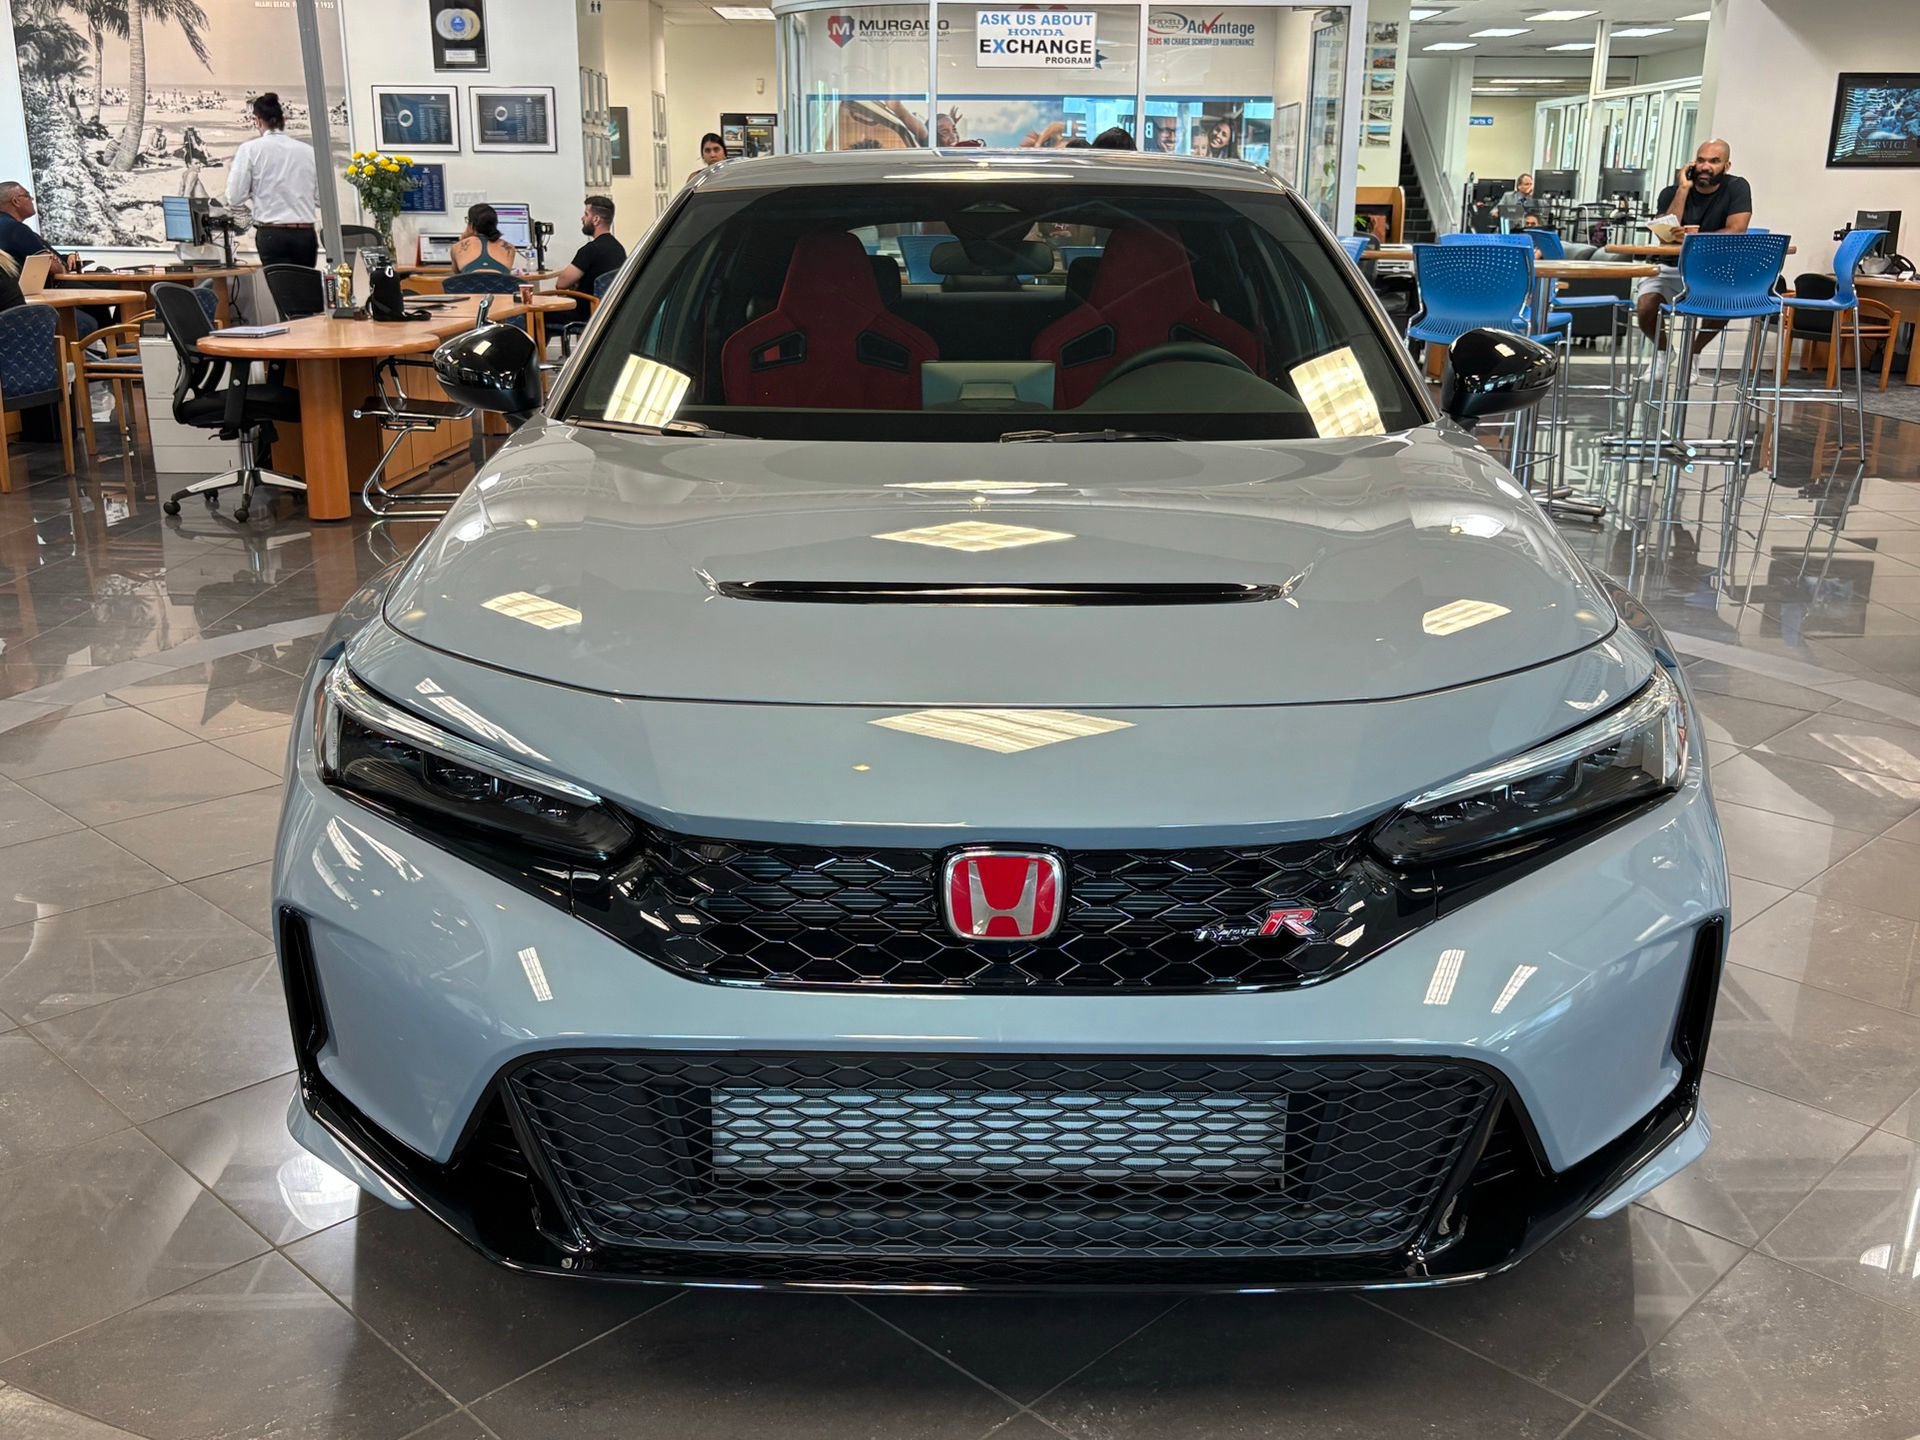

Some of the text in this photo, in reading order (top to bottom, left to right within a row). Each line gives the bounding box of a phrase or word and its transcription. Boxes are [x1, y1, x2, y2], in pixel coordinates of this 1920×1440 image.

[980, 14, 1093, 26] ASK US ABOUT
[1007, 28, 1065, 37] HONDA
[979, 39, 1092, 54] EXCHANGE
[1171, 38, 1190, 46] CHARGE
[1221, 38, 1255, 46] MAINTENANCE
[1045, 57, 1092, 65] PROGRAM
